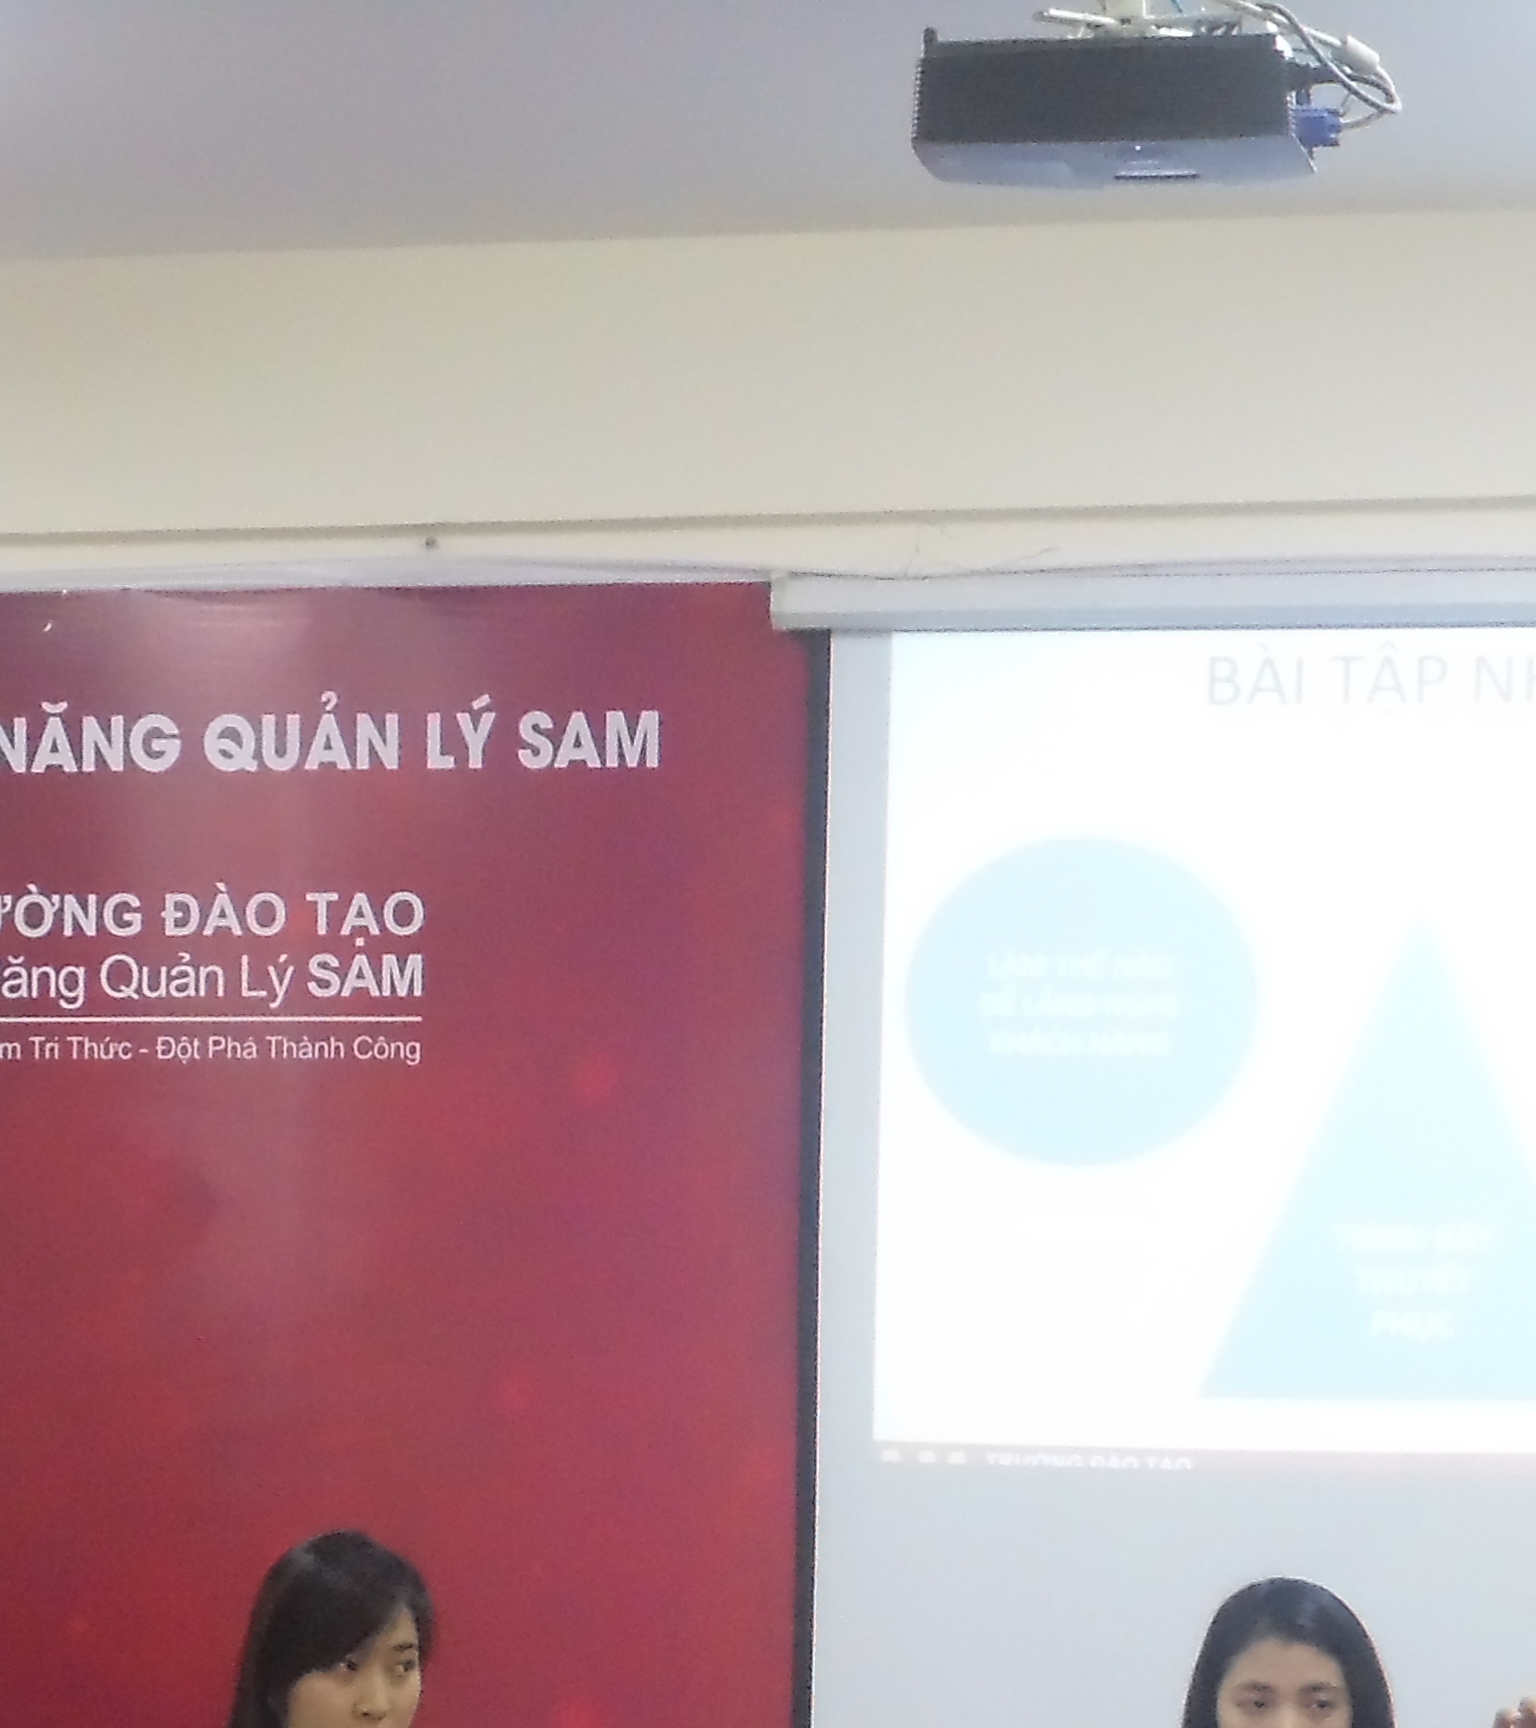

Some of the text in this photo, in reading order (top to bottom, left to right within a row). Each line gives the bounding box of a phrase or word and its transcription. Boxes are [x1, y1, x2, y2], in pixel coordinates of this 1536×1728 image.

[1207, 642, 1304, 706] BÀI
[204, 691, 398, 772] QUẢN
[426, 694, 497, 769] LÝ
[517, 710, 660, 769] SAM
[161, 882, 286, 937] ĐÀO
[307, 891, 424, 947] TẠO
[100, 952, 224, 1000] Quản
[240, 953, 294, 1008] Lý
[307, 953, 422, 998] SAM
[66, 1036, 133, 1061] Thức
[156, 1036, 201, 1065] Đột
[266, 1036, 345, 1061] Thành
[353, 1035, 421, 1064] Công
